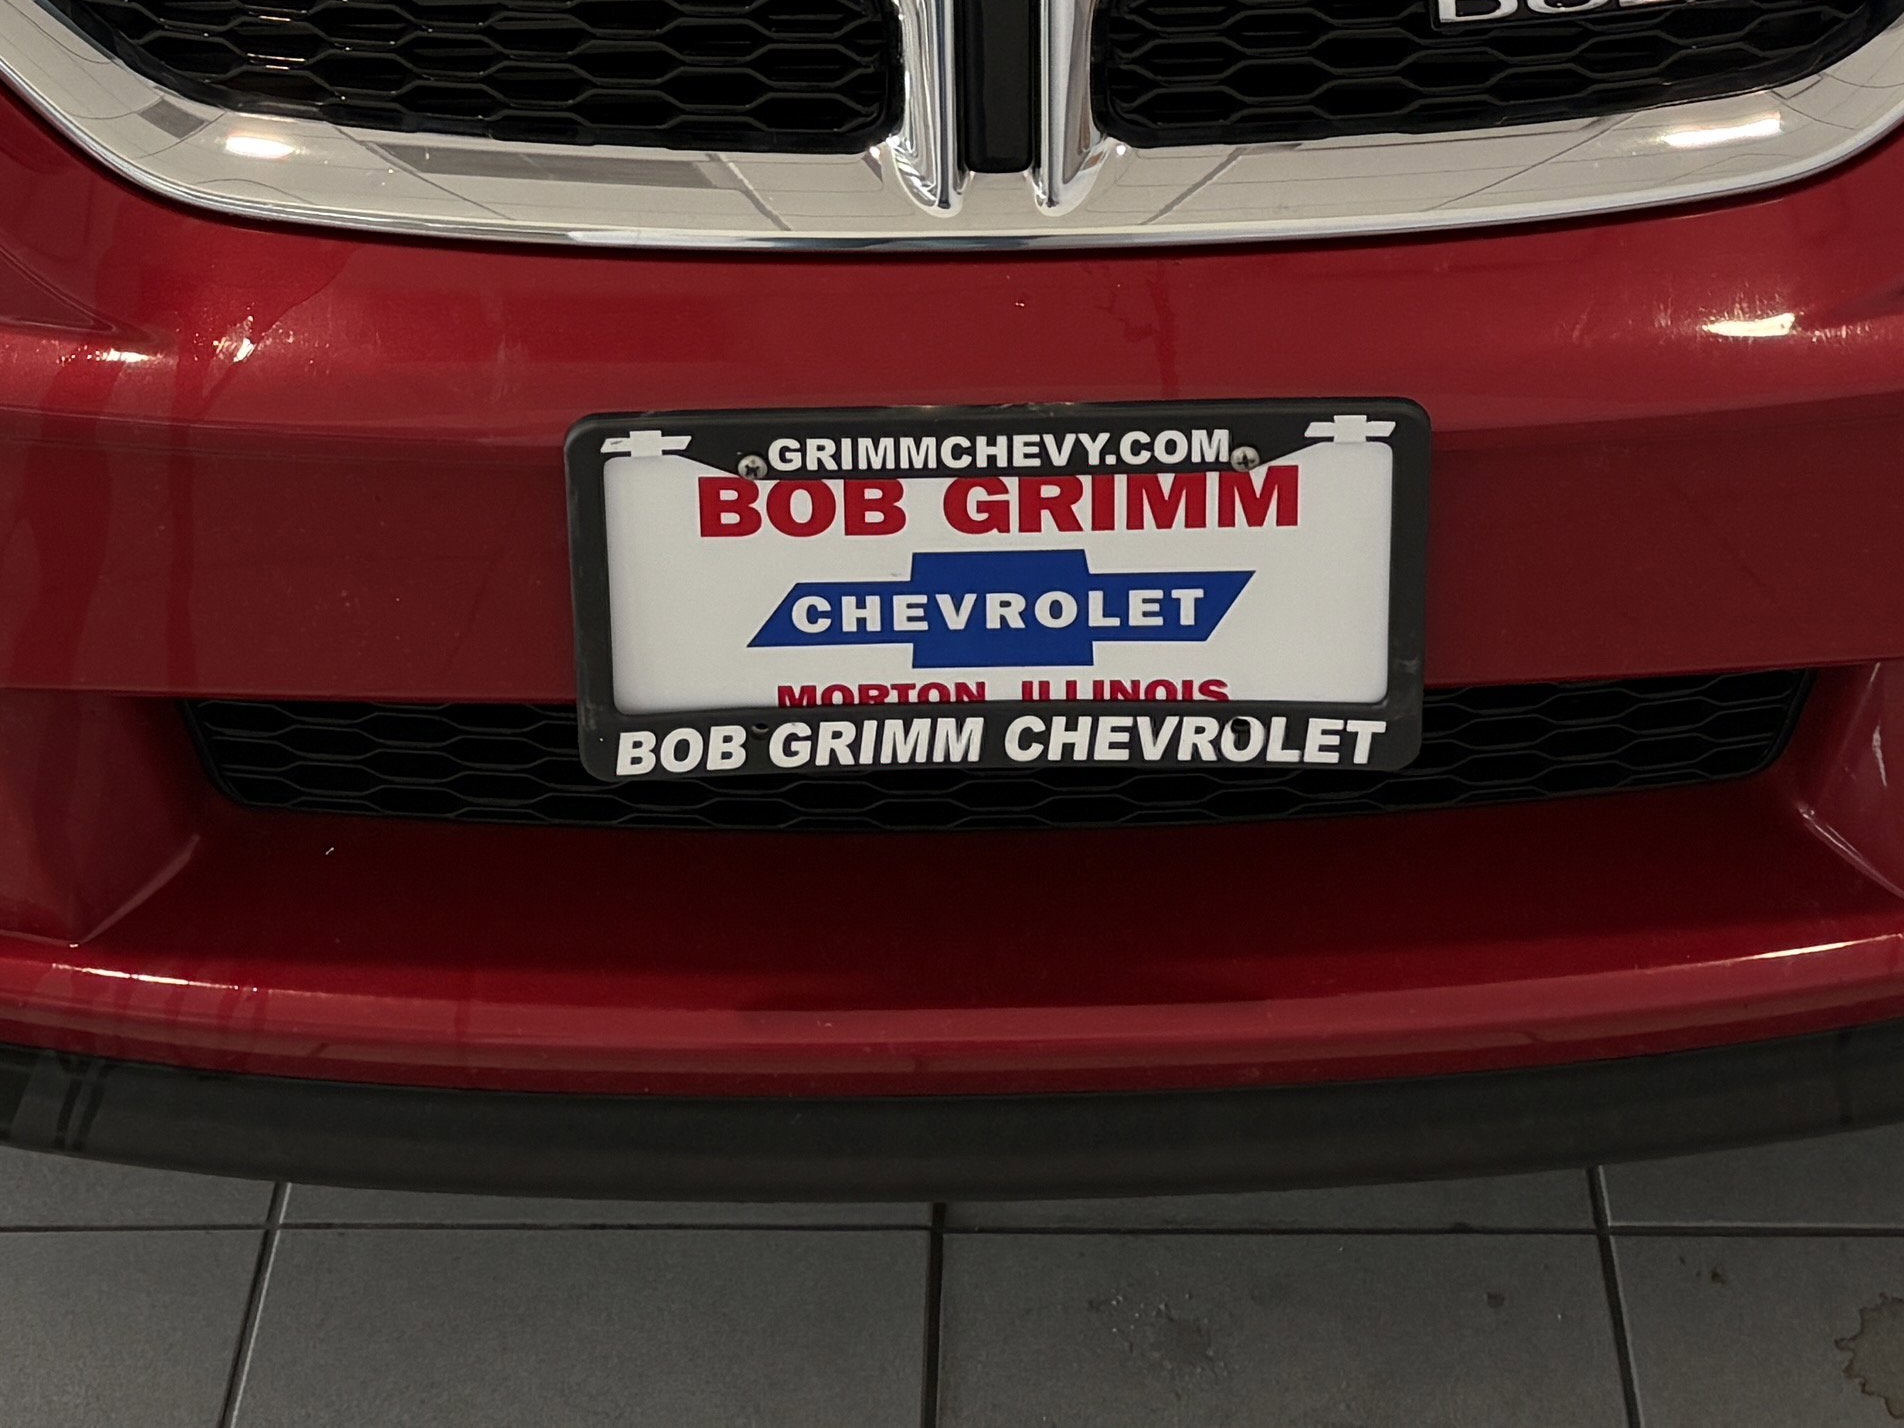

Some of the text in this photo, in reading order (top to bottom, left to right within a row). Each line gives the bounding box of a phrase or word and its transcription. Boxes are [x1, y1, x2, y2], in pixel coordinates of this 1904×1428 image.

[768, 429, 1230, 472] GRIMMCHEVY.COM
[698, 464, 1299, 538] BOB GRIMM
[791, 588, 1204, 634] CHEVROLET
[615, 715, 1387, 776] BOB GRIMM CHEVROLET
